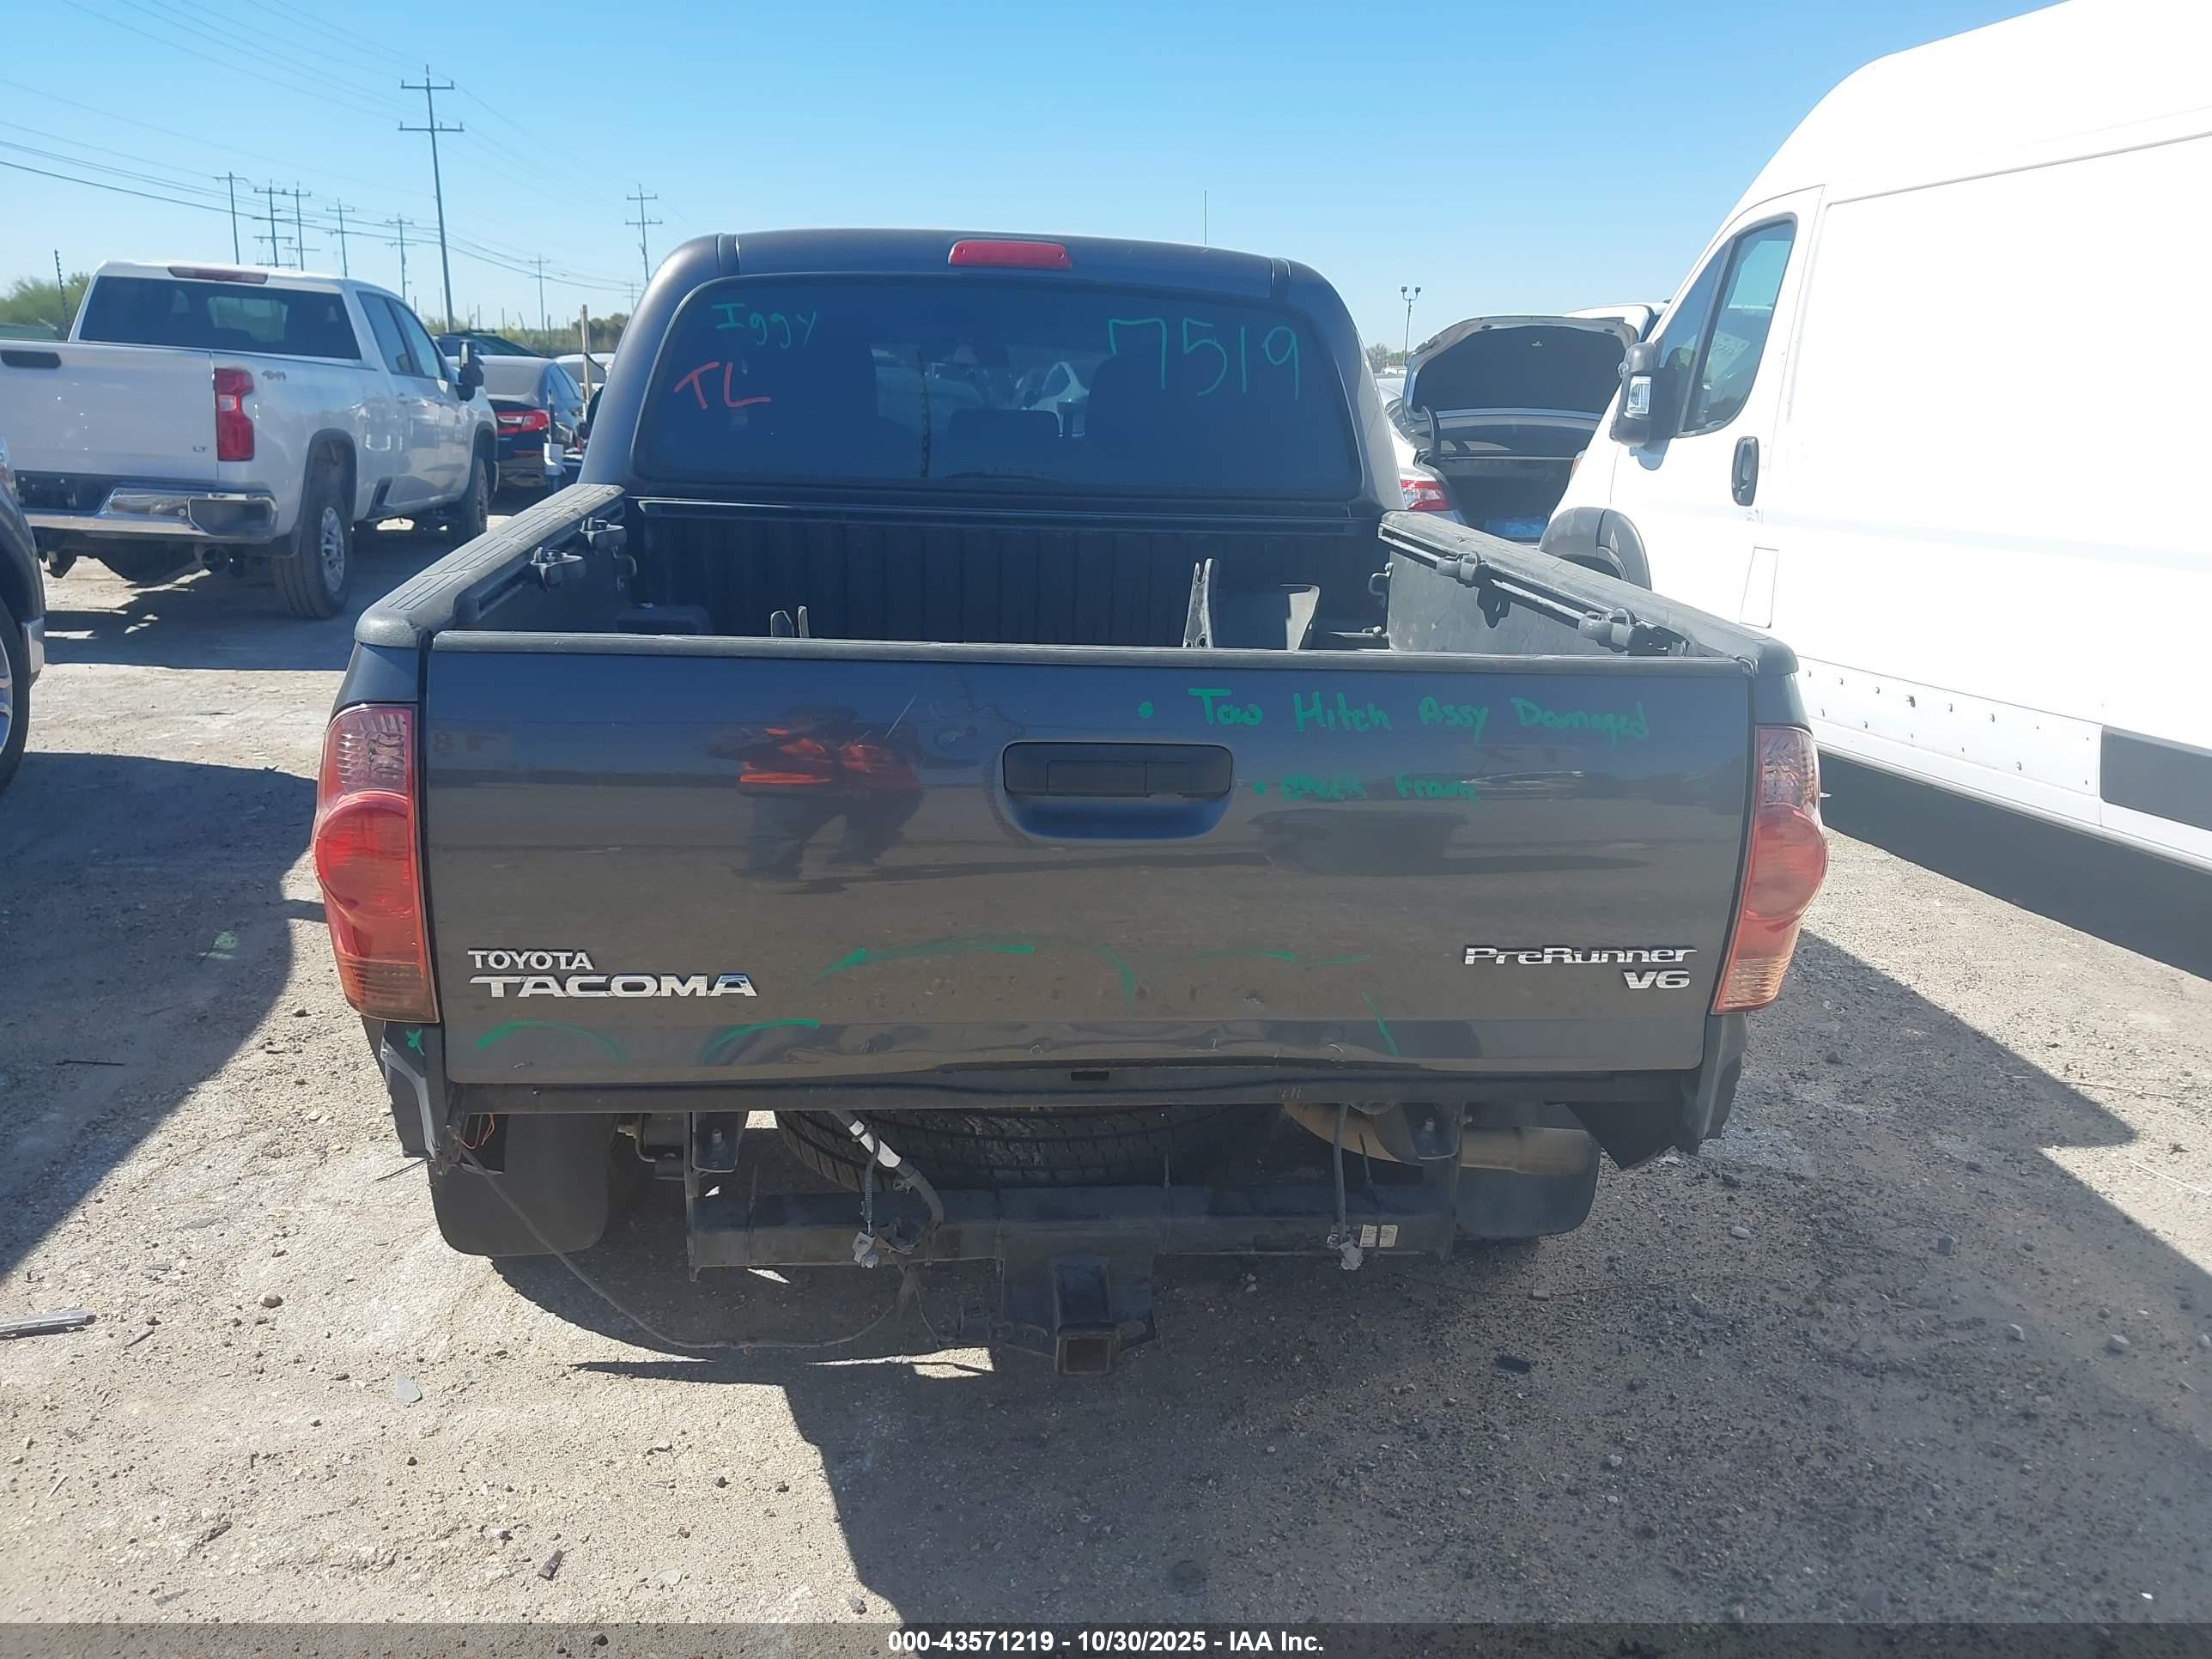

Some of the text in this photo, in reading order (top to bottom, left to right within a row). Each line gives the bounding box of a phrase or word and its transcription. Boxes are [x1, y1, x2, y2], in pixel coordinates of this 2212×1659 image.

[711, 302, 817, 349] Iggy
[1108, 316, 1300, 401] 7519
[673, 361, 771, 410] TL
[1292, 691, 1393, 732] Hitch
[1418, 696, 1490, 743] Assy
[467, 948, 594, 970] TOYOTA
[1464, 945, 1698, 964] PreRunner
[469, 974, 758, 998] TACOMA
[1622, 969, 1691, 990] V6
